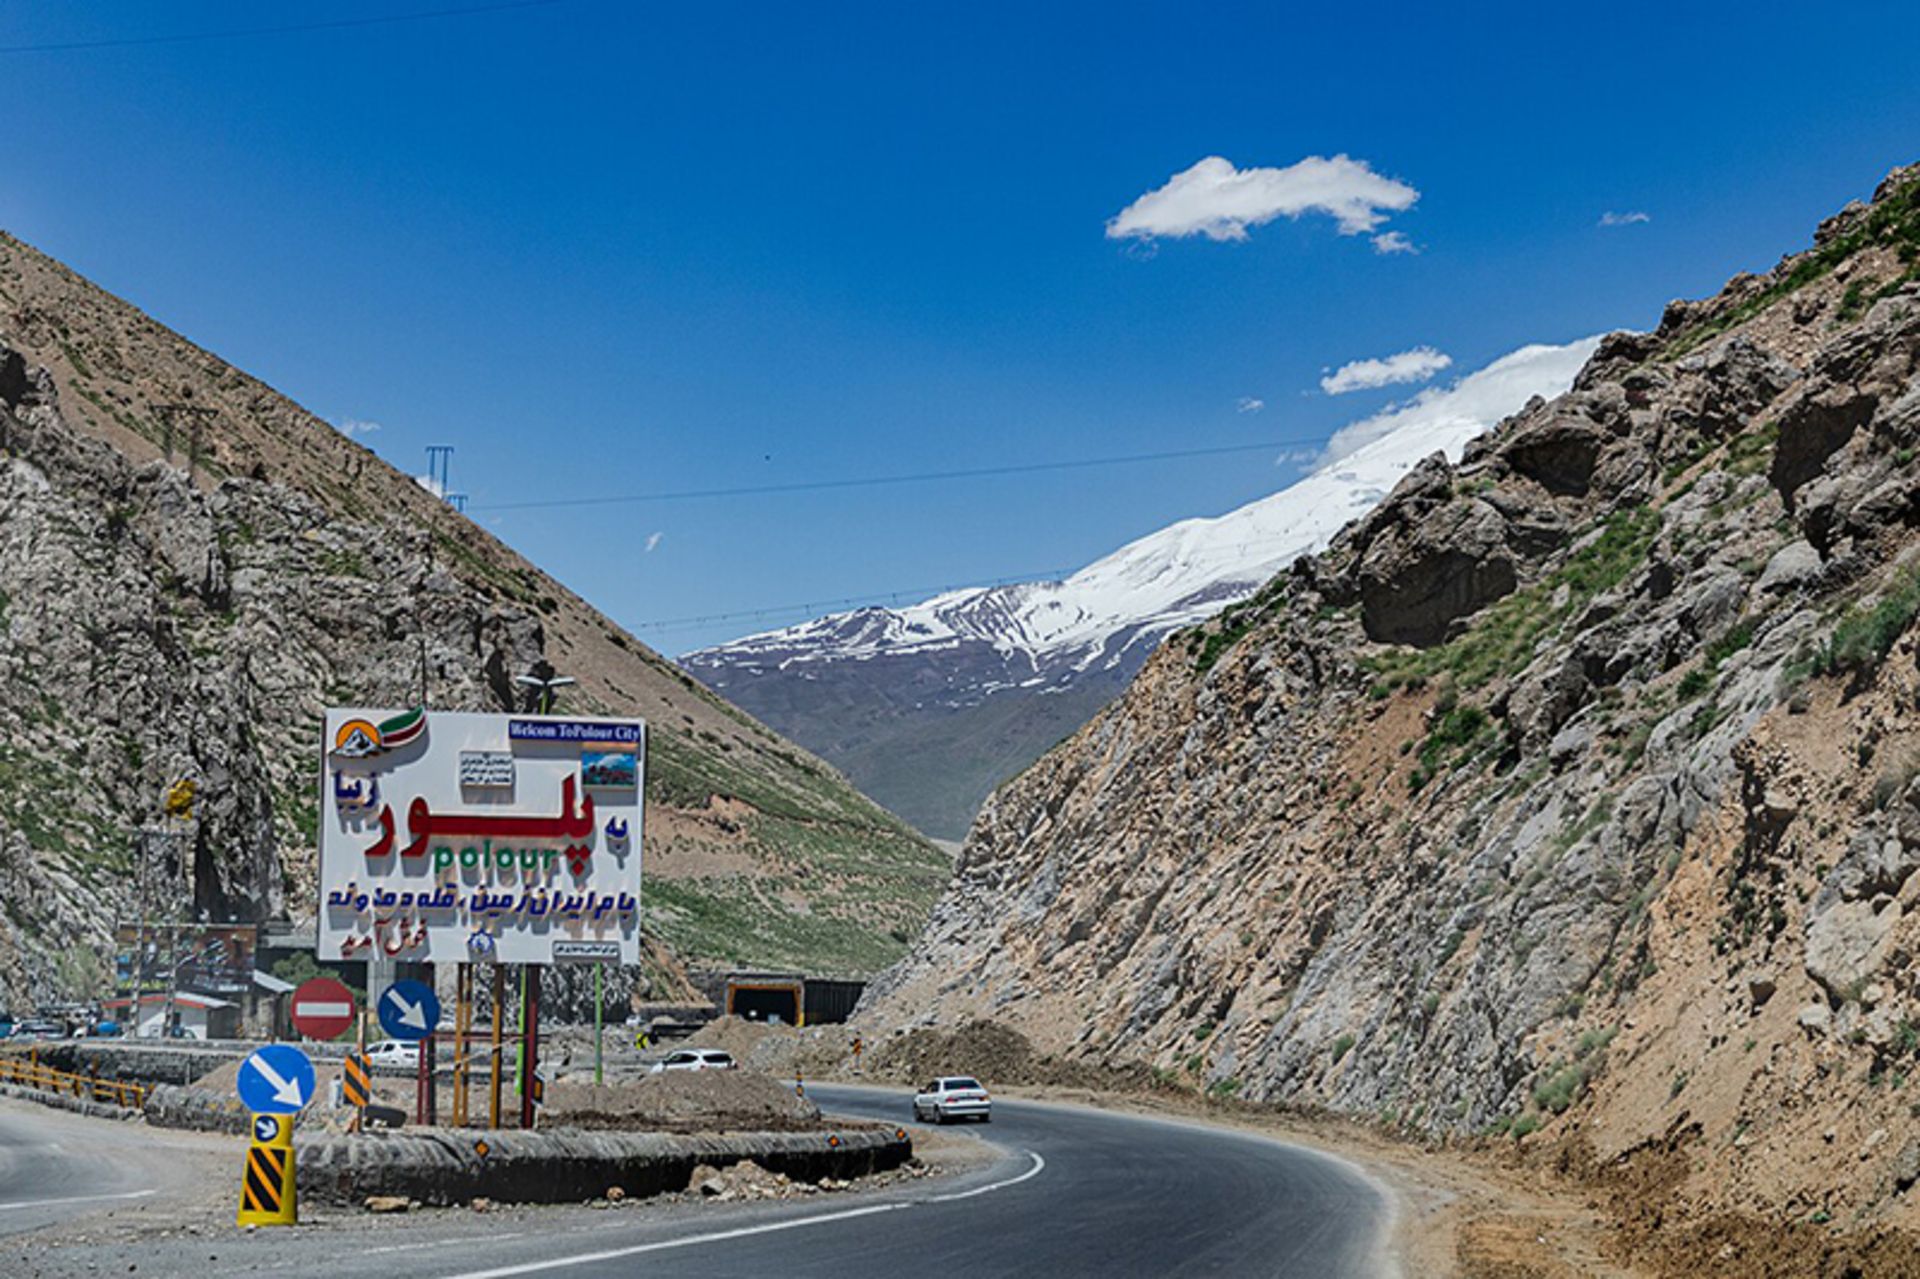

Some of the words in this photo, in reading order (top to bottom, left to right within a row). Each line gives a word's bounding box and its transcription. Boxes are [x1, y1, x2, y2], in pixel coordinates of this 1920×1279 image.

[511, 722, 556, 736] Welcom
[615, 726, 639, 741] City
[365, 773, 595, 876] پلور
[434, 839, 559, 874] polour
[328, 882, 414, 912] دماوند
[417, 882, 457, 908] قله
[528, 887, 596, 919] ایران
[593, 892, 637, 919] بام
[341, 918, 392, 958] آمدید
[384, 917, 428, 956] خوش
